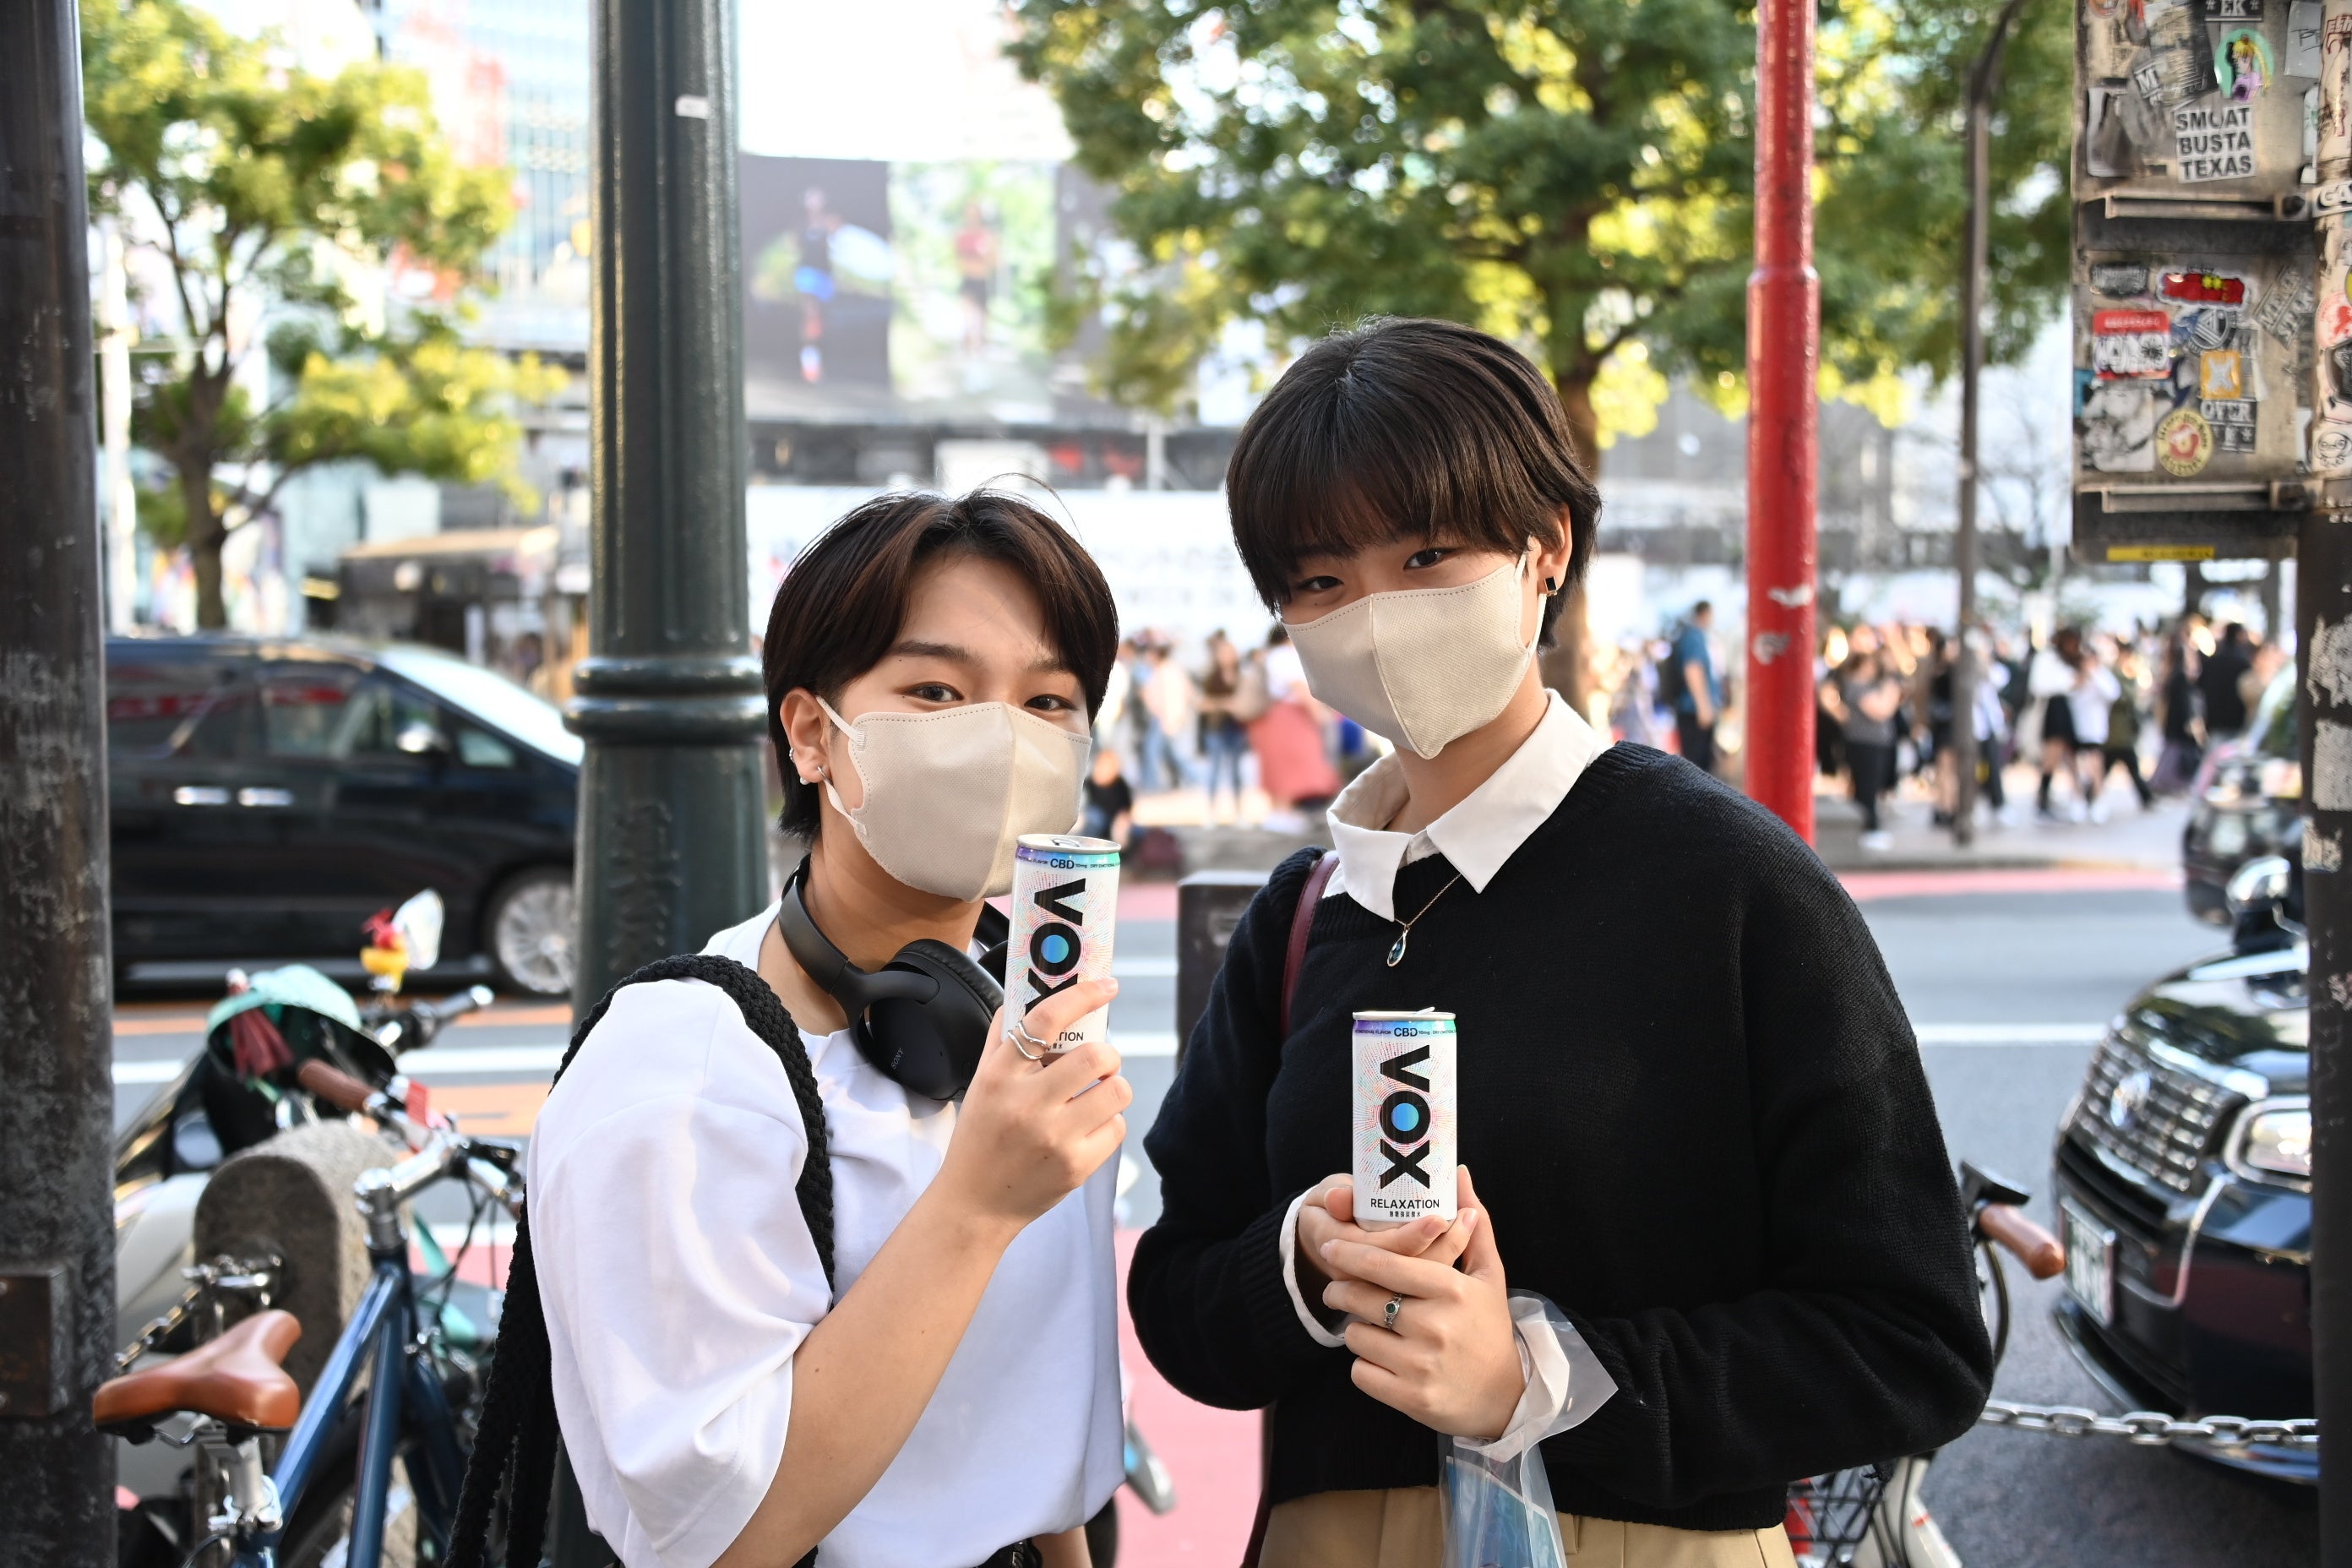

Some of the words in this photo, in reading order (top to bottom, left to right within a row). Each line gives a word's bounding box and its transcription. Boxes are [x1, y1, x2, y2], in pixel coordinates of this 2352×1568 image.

[2180, 131, 2251, 155] BUSTA
[2180, 155, 2252, 180] TEXAS
[1050, 858, 1075, 869] CBD
[1025, 878, 1086, 1016] VOX
[1393, 1027, 1418, 1037] CBD
[890, 1047, 904, 1070] SONY
[1380, 1044, 1431, 1190] VOX
[1370, 1197, 1440, 1210] RELAXATION
